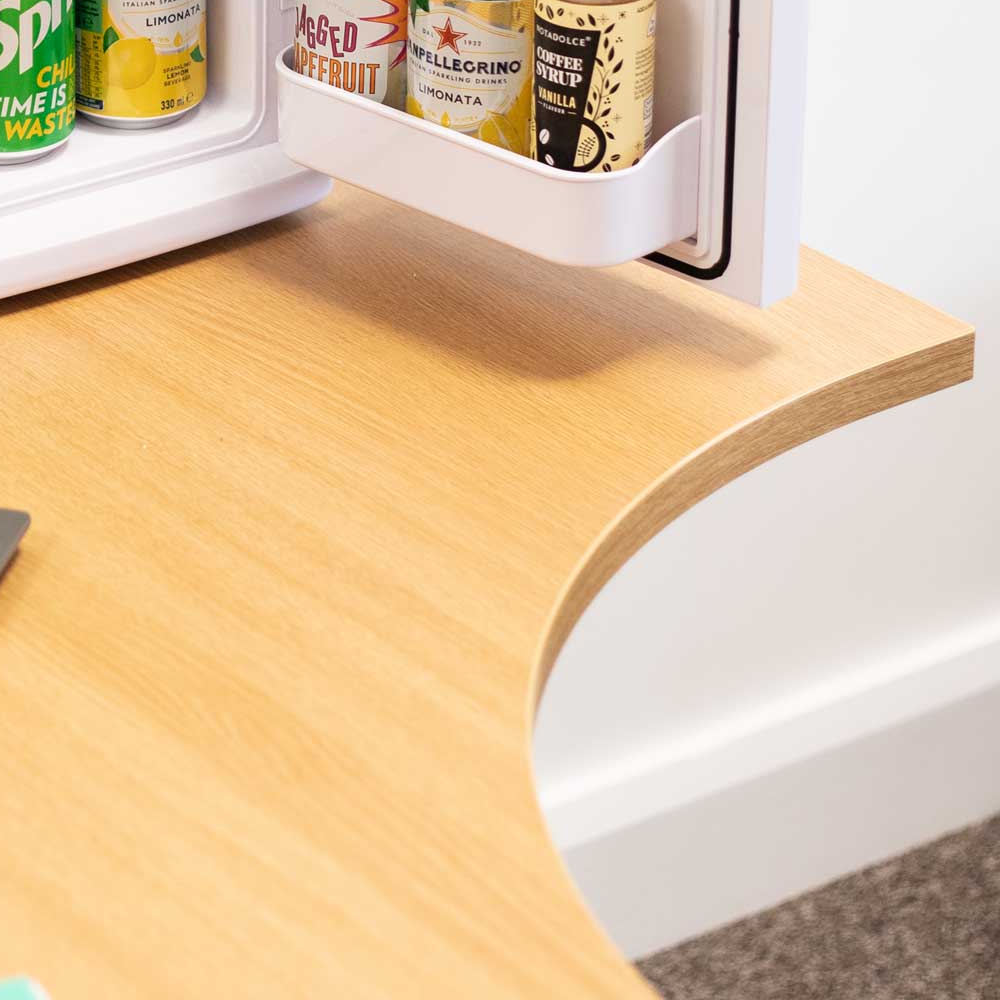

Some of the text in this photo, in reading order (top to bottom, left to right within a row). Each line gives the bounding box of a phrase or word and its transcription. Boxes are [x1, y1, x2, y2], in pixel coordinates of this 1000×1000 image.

[146, 3, 201, 28] LIMONATA
[536, 46, 583, 72] COFFEE
[536, 60, 583, 88] SYRUP
[50, 83, 67, 110] IS
[160, 98, 175, 111] 330
[418, 82, 483, 106] LIMONATA
[538, 85, 577, 110] VANILLA
[4, 97, 76, 141] WASTE
